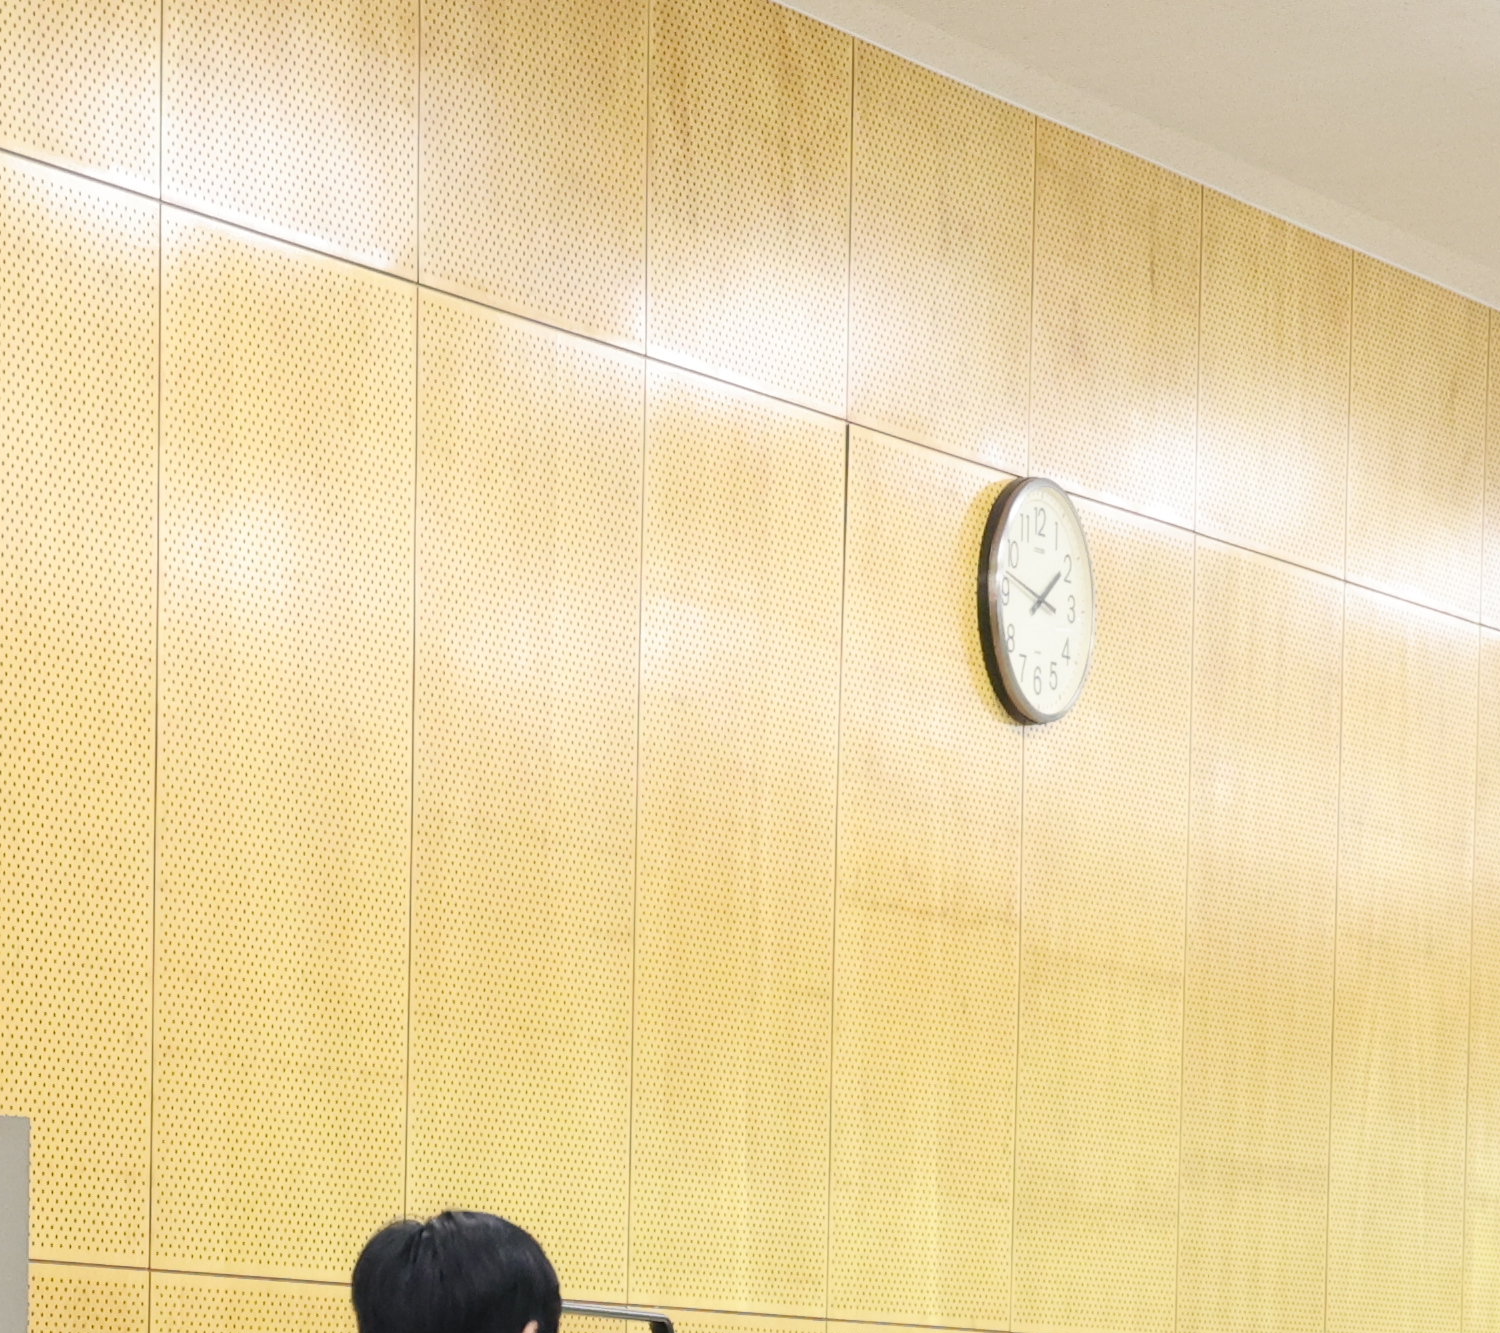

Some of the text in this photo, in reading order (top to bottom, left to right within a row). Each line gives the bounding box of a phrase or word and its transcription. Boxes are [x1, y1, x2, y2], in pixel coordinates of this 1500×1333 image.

[1020, 513, 1030, 543] 11
[1034, 506, 1046, 537] 12
[1055, 521, 1059, 551] 1
[1007, 539, 1019, 569] 10
[1063, 554, 1072, 584] 2
[1001, 576, 1010, 606] 9
[1067, 595, 1075, 624] 3
[1007, 623, 1015, 653] 8
[1061, 637, 1071, 665] 4
[1018, 654, 1027, 683] 7
[1033, 666, 1042, 695] 6
[1049, 661, 1058, 690] 5
